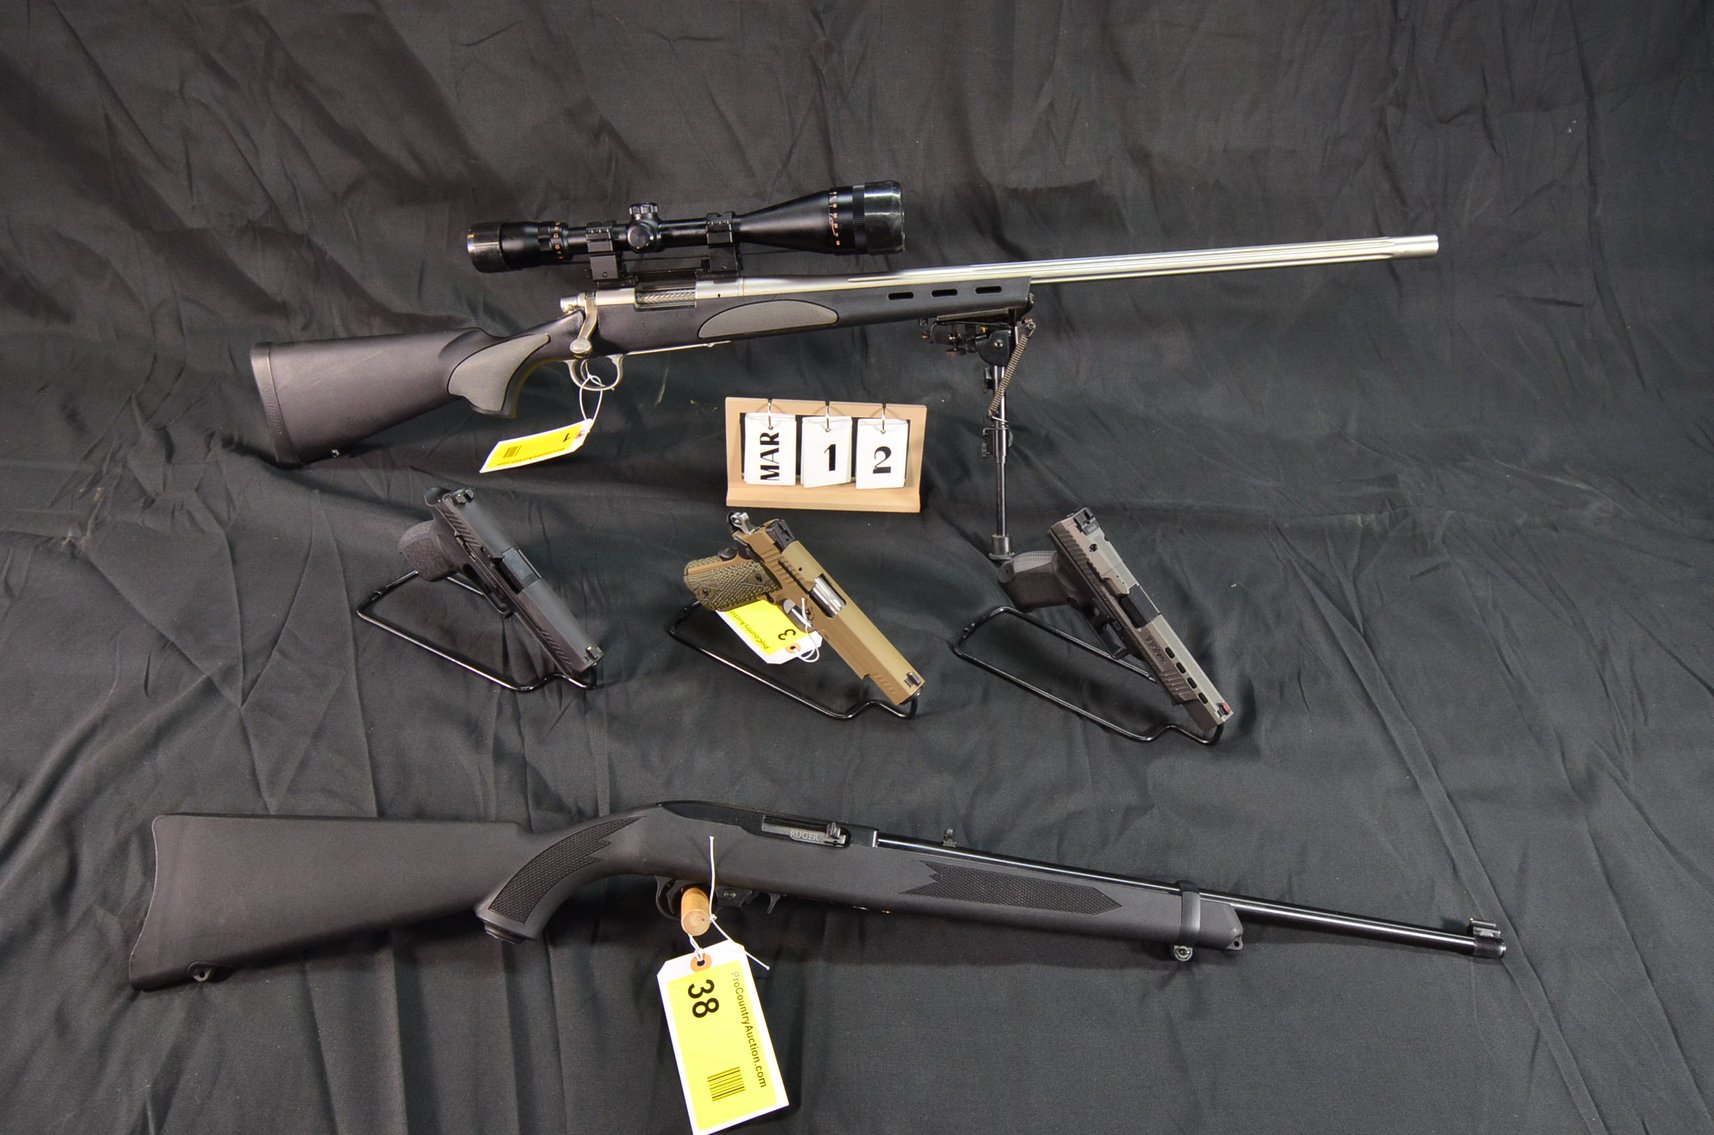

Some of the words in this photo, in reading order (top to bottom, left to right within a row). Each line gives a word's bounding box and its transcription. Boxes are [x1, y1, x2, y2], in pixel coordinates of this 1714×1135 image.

[759, 431, 780, 481] MAR
[824, 443, 836, 472] 1
[872, 445, 892, 474] 2
[778, 629, 796, 641] 3
[790, 829, 819, 842] RUGER
[687, 979, 720, 1018] 38
[730, 971, 767, 1088] ProCountryAuction.com
